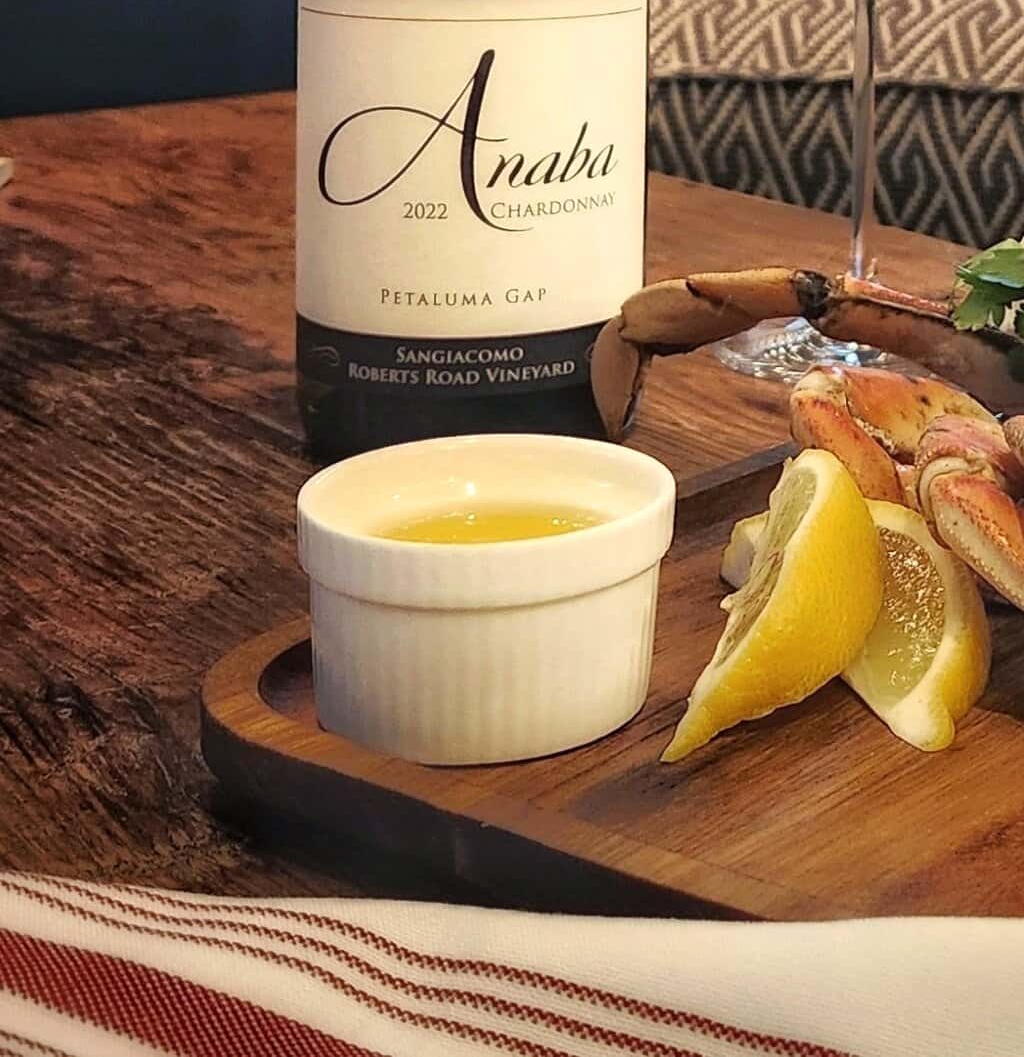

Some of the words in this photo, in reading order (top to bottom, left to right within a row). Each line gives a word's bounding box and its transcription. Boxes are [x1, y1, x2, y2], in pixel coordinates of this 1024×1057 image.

[318, 49, 618, 231] Anaba
[403, 202, 448, 220] 2022
[490, 191, 617, 220] CHARDONNAY
[380, 288, 493, 306] PETALUMA
[505, 287, 548, 304] GAP
[396, 346, 524, 364] SANGIACOMO
[349, 362, 419, 385] ROBERTS
[426, 367, 480, 385] ROAD
[486, 360, 576, 383] VINEYARD
